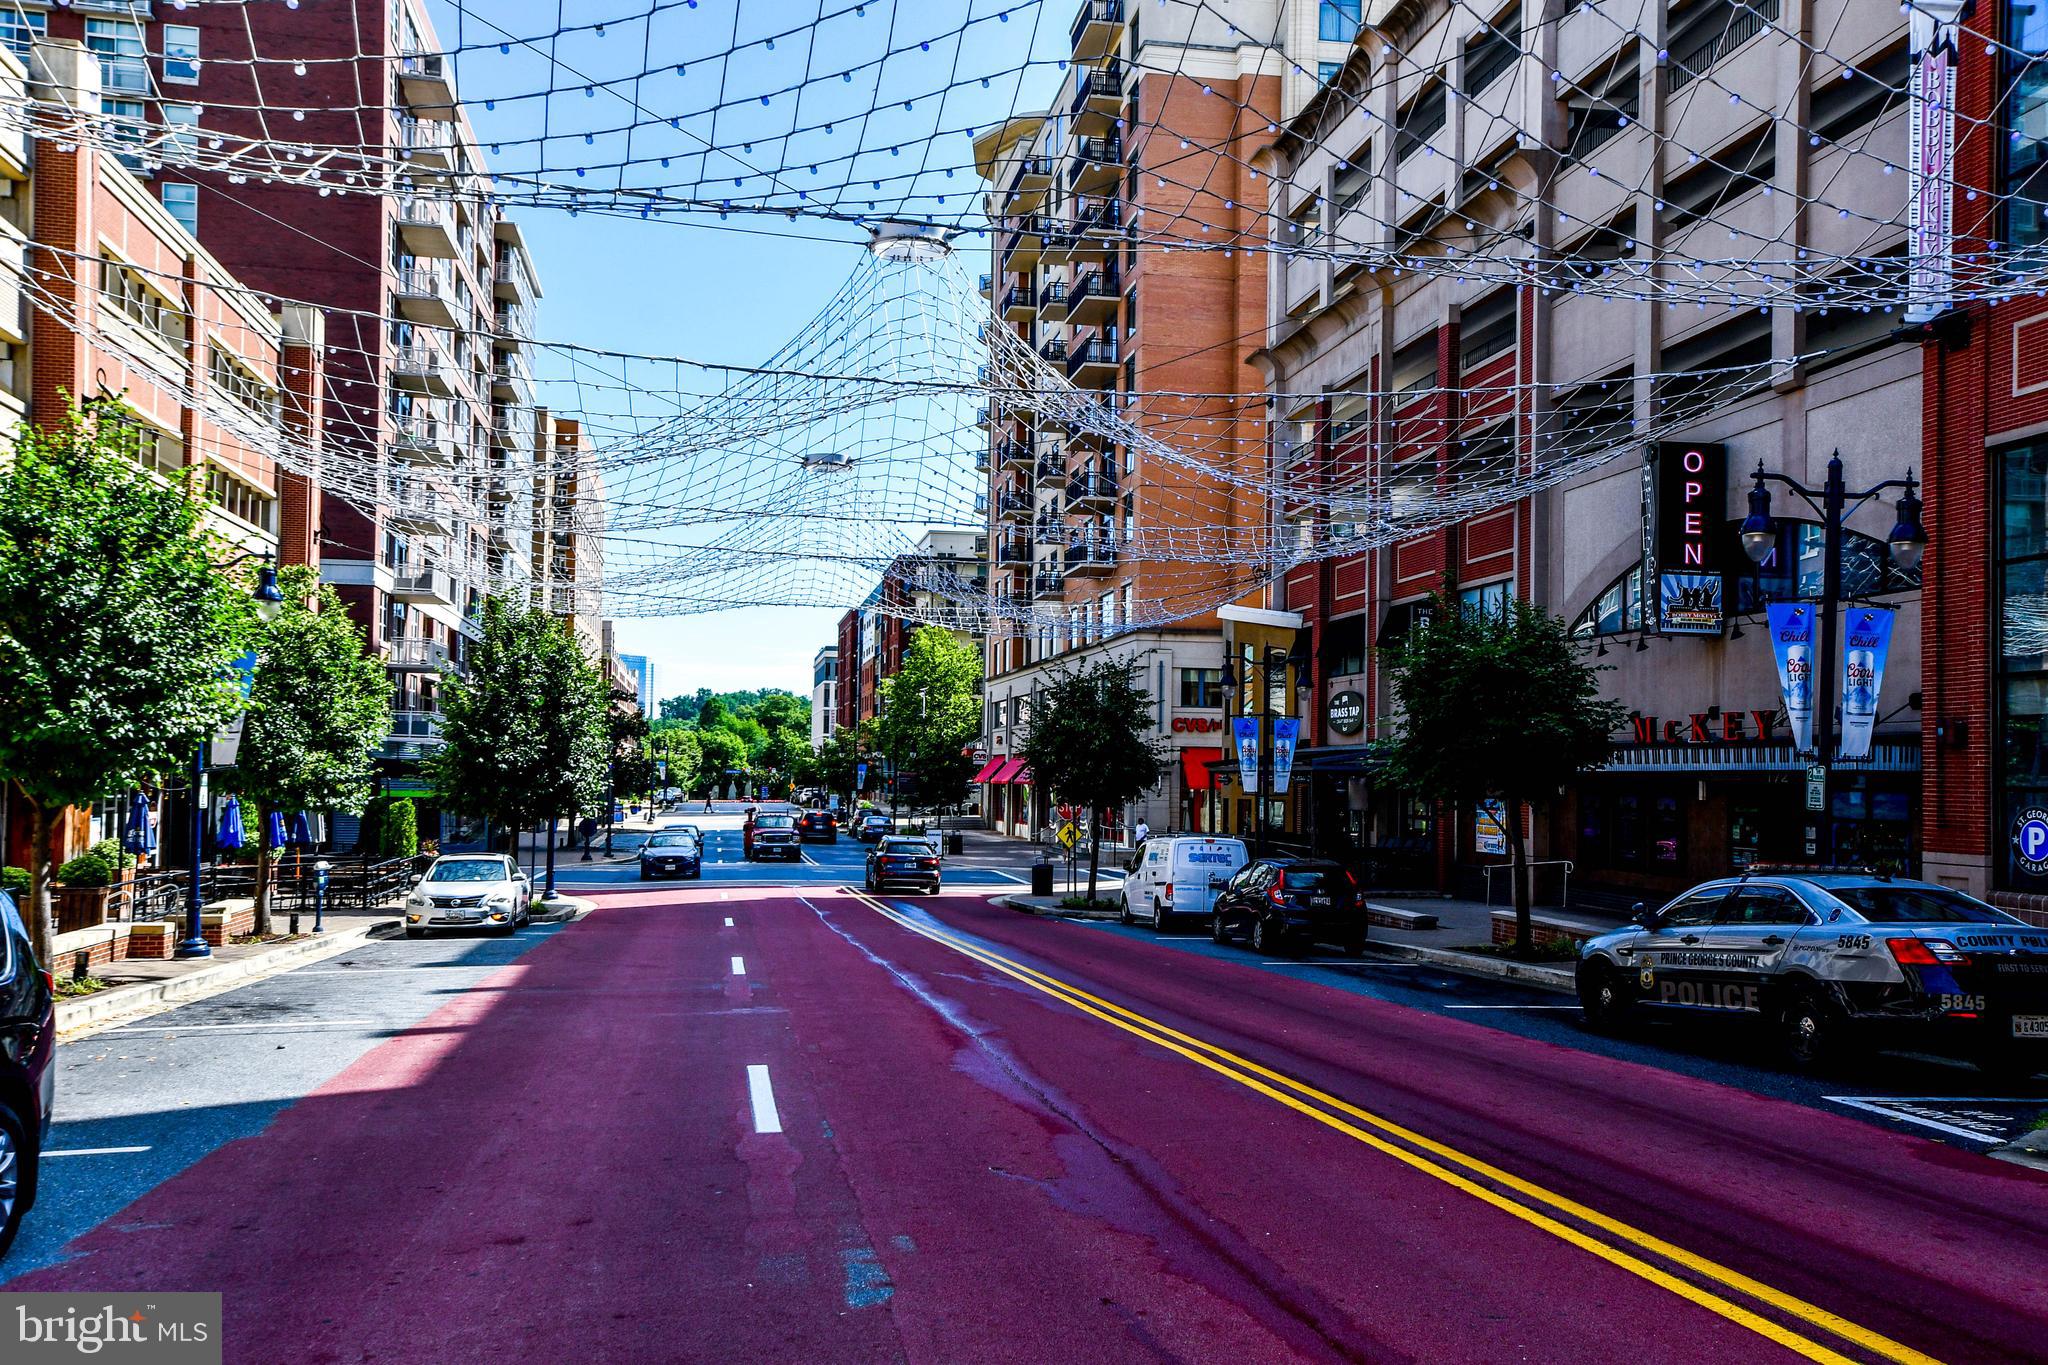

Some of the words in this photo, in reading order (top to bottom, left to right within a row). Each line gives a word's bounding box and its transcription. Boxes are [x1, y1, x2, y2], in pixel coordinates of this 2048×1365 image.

[1683, 451, 1702, 566] OPEN
[1849, 635, 1878, 648] Chill
[1787, 658, 1811, 673] Coo
[1847, 663, 1874, 678] Coors
[1848, 678, 1873, 687] LIGHT
[1330, 706, 1348, 719] BRASS
[1348, 705, 1360, 717] TAP
[2016, 815, 2028, 828] ST.
[2028, 826, 2046, 855] P
[1838, 935, 1871, 950] 5845
[1956, 935, 2015, 948] COUNTY
[1660, 952, 1687, 966] PRINCE
[1726, 954, 1760, 969] COUNTY
[1660, 981, 1760, 1008] POLICE
[1941, 993, 1986, 1011] 5845
